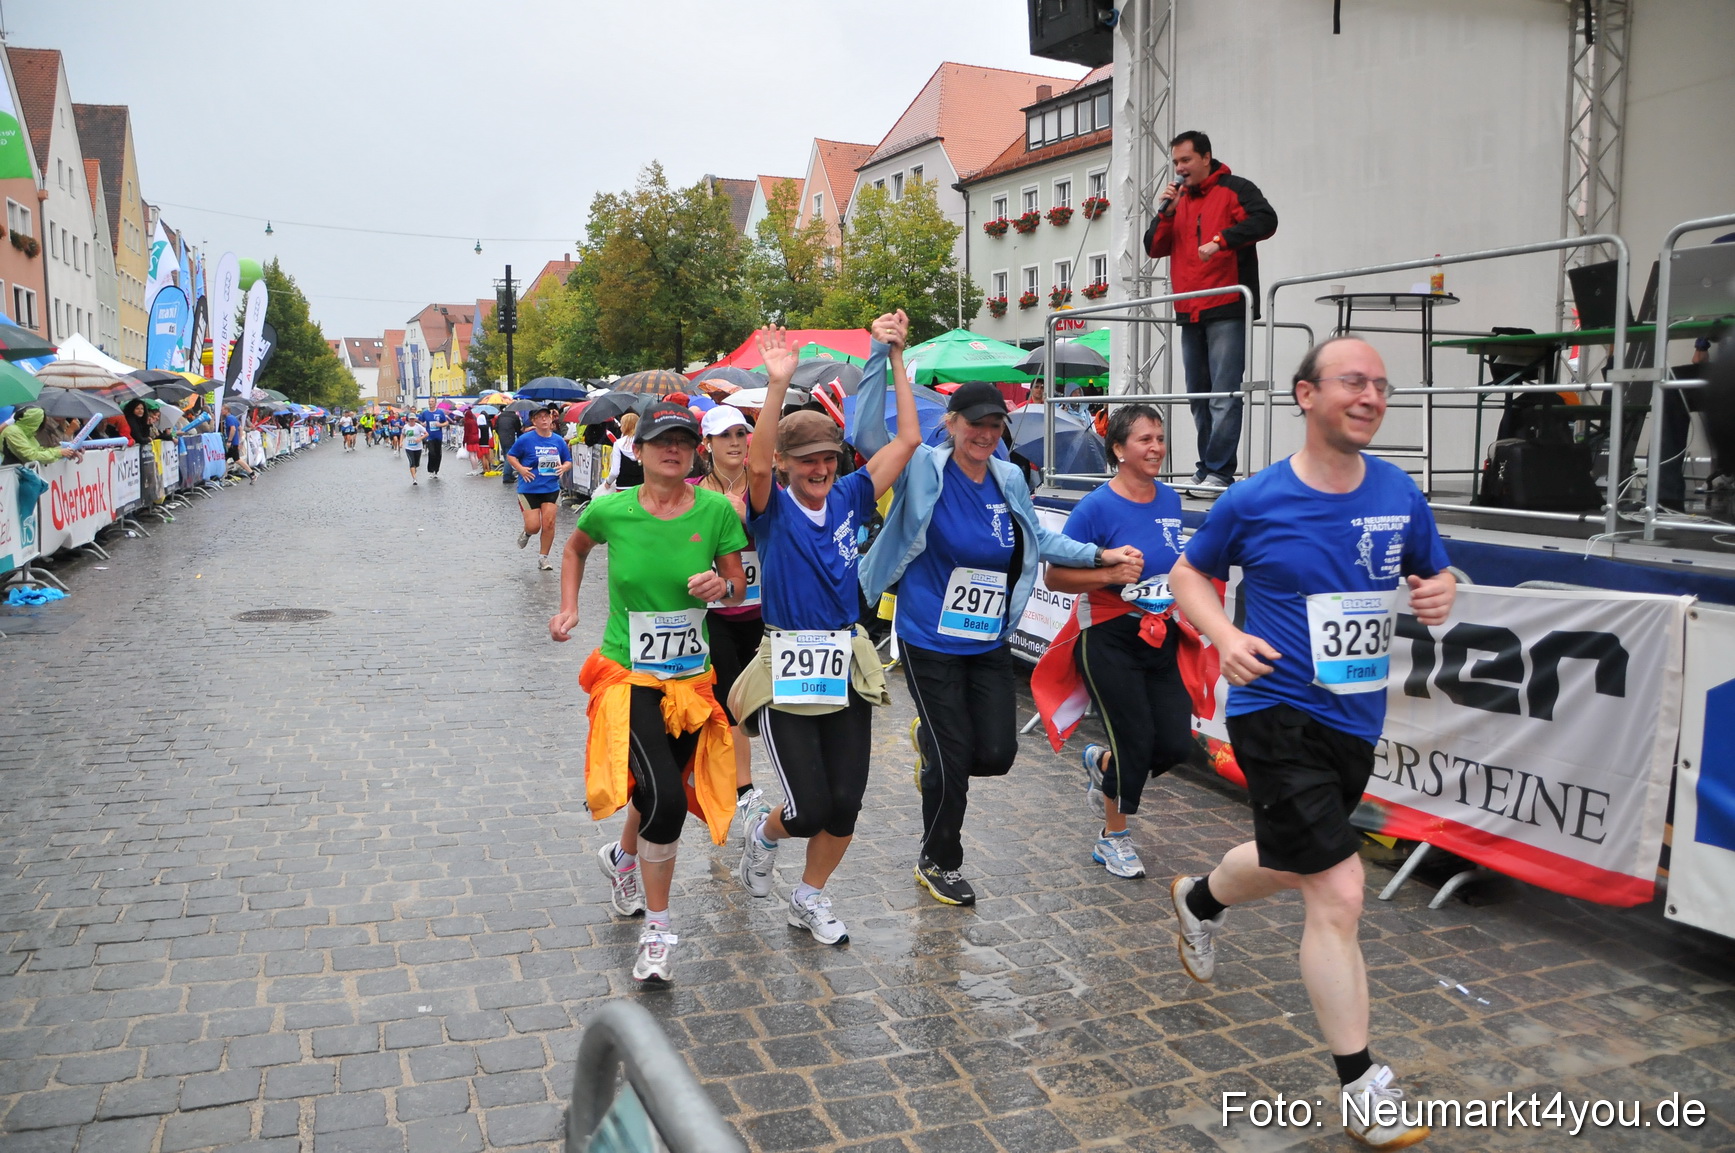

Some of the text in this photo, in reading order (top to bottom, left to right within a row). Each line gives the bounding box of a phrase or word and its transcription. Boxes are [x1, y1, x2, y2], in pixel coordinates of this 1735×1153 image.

[158, 307, 177, 319] maxi
[219, 343, 227, 375] Audi
[246, 354, 255, 382] Audi
[51, 467, 107, 531] Oberbank
[1350, 518, 1364, 527] 12.
[1363, 523, 1404, 532] STADTLAUF
[971, 573, 998, 583] BOCK
[951, 586, 1006, 616] 2977
[1342, 598, 1382, 609] BOCK
[654, 614, 688, 625] BOCK
[963, 617, 989, 631] Beate
[640, 627, 702, 661] 2773
[797, 634, 828, 643] BOCK
[1322, 617, 1392, 657] 3239
[780, 648, 844, 678] 2976
[1346, 664, 1377, 679] Frank
[801, 681, 827, 693] Doris
[1369, 736, 1611, 846] ERSTEINE
